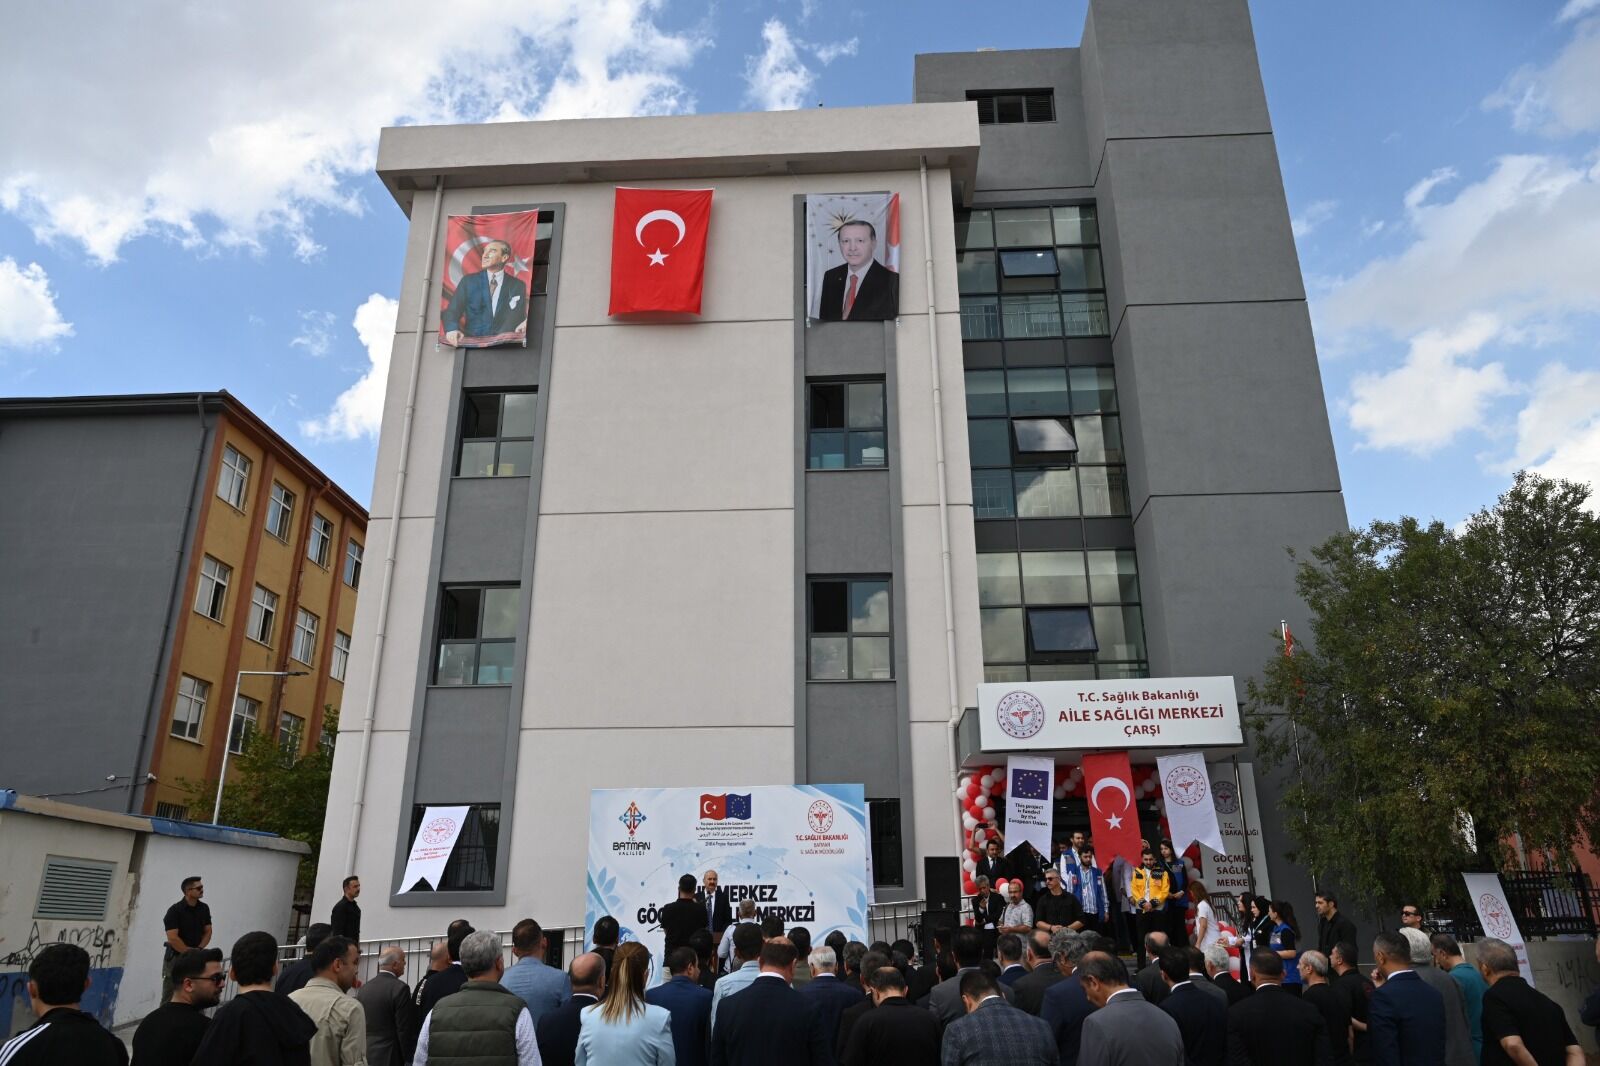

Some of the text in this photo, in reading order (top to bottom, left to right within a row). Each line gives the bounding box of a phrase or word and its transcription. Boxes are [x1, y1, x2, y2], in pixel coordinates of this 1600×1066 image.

[1077, 690, 1200, 704] T.C. Sağlık Bakanlığı
[1058, 704, 1224, 722] AİLE SAĞLIĞI MERKEZİ
[1124, 724, 1161, 737] ÇARŞI
[612, 841, 651, 851] BATMAN
